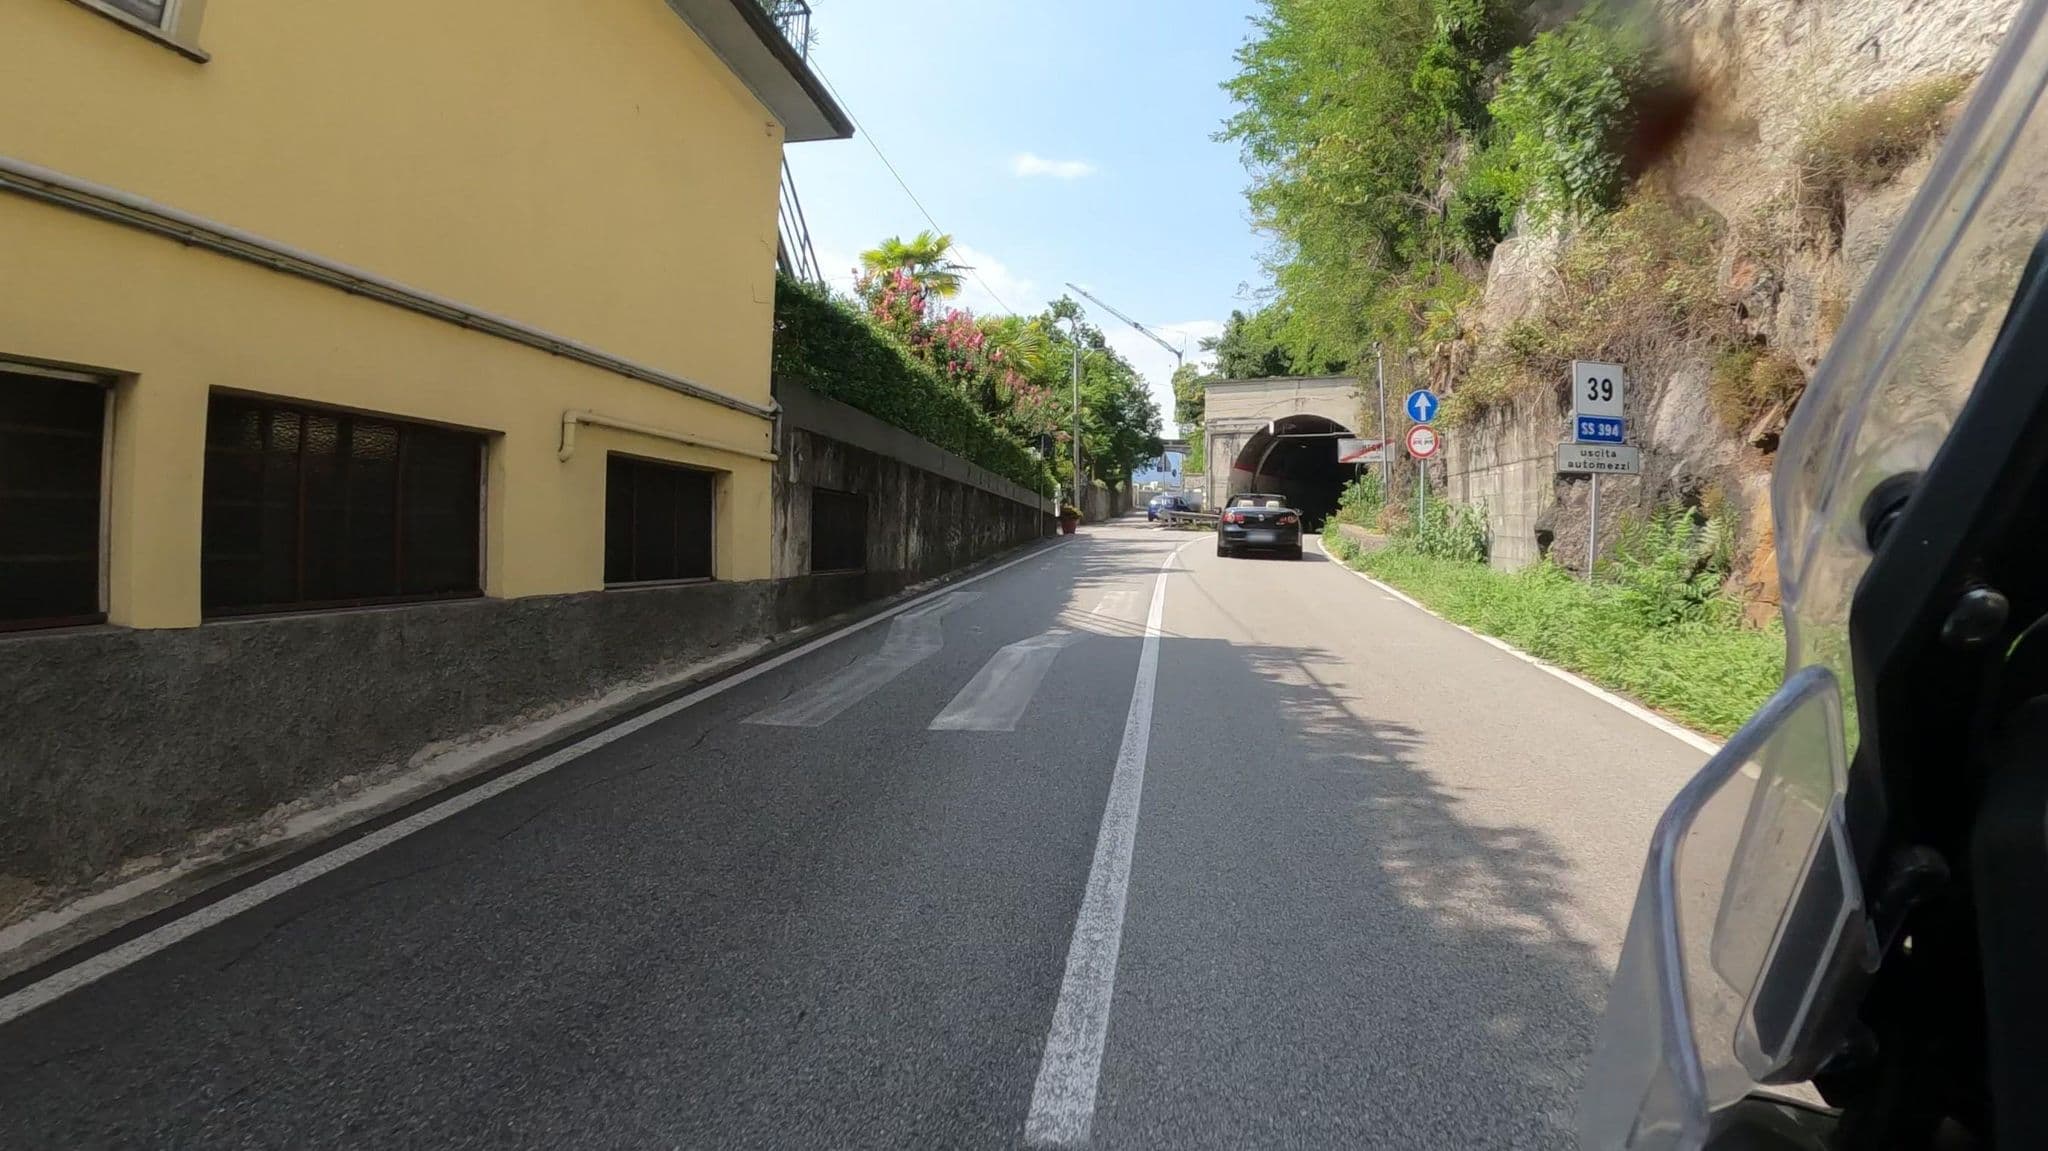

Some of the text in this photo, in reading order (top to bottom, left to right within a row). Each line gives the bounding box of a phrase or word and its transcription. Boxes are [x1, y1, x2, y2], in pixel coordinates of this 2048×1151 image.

[1587, 377, 1613, 402] 39
[1581, 422, 1619, 437] SS 394
[1580, 448, 1617, 458] uscita
[1567, 460, 1630, 470] automezzi
